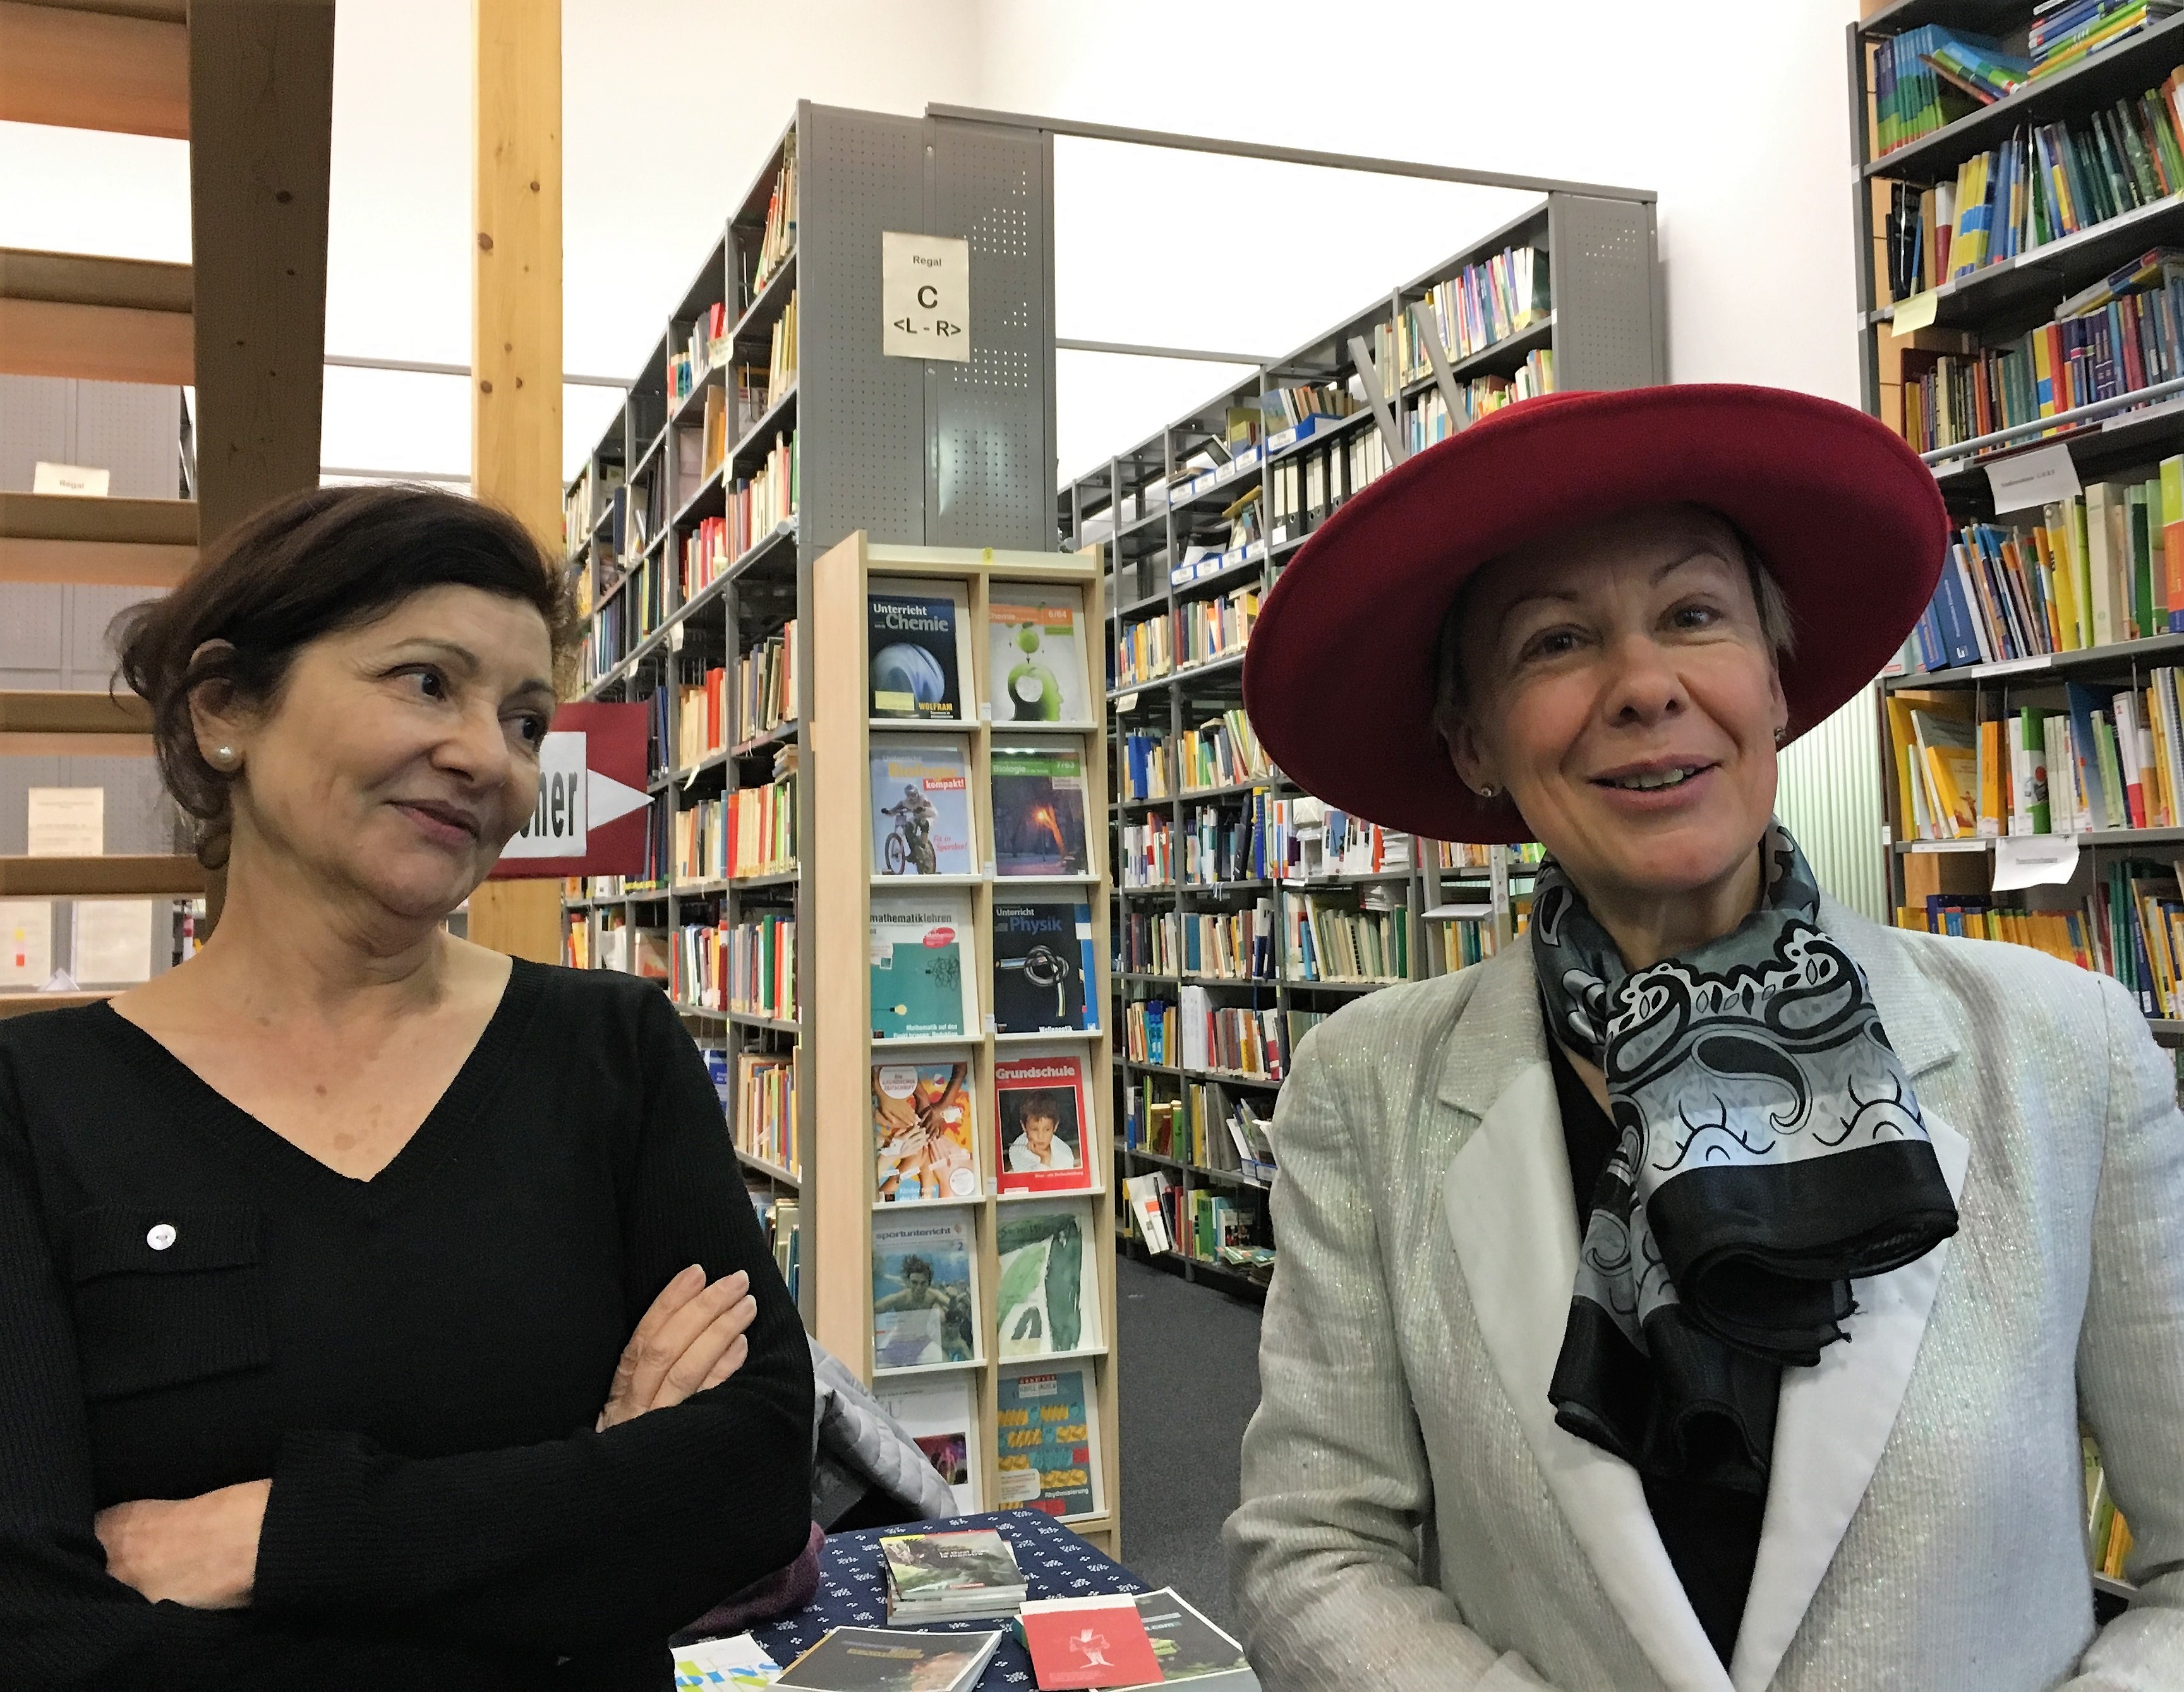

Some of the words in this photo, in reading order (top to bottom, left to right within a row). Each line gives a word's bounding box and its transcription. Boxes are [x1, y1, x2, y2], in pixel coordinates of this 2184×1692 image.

[913, 255, 941, 267] Regal
[917, 285, 938, 309] C
[59, 479, 85, 489] Regal
[873, 604, 927, 616] Unterricht
[886, 613, 949, 632] Chemie
[918, 702, 953, 711] WOLFRAM
[992, 765, 1026, 775] Biologie
[926, 779, 964, 790] kompakt!
[519, 771, 578, 838] ner
[996, 908, 1035, 916] Unterricht
[1010, 915, 1063, 935] Physik
[996, 1065, 1075, 1080] Grundschule
[875, 1227, 951, 1240] sportunterricht
[957, 1242, 964, 1251] 2
